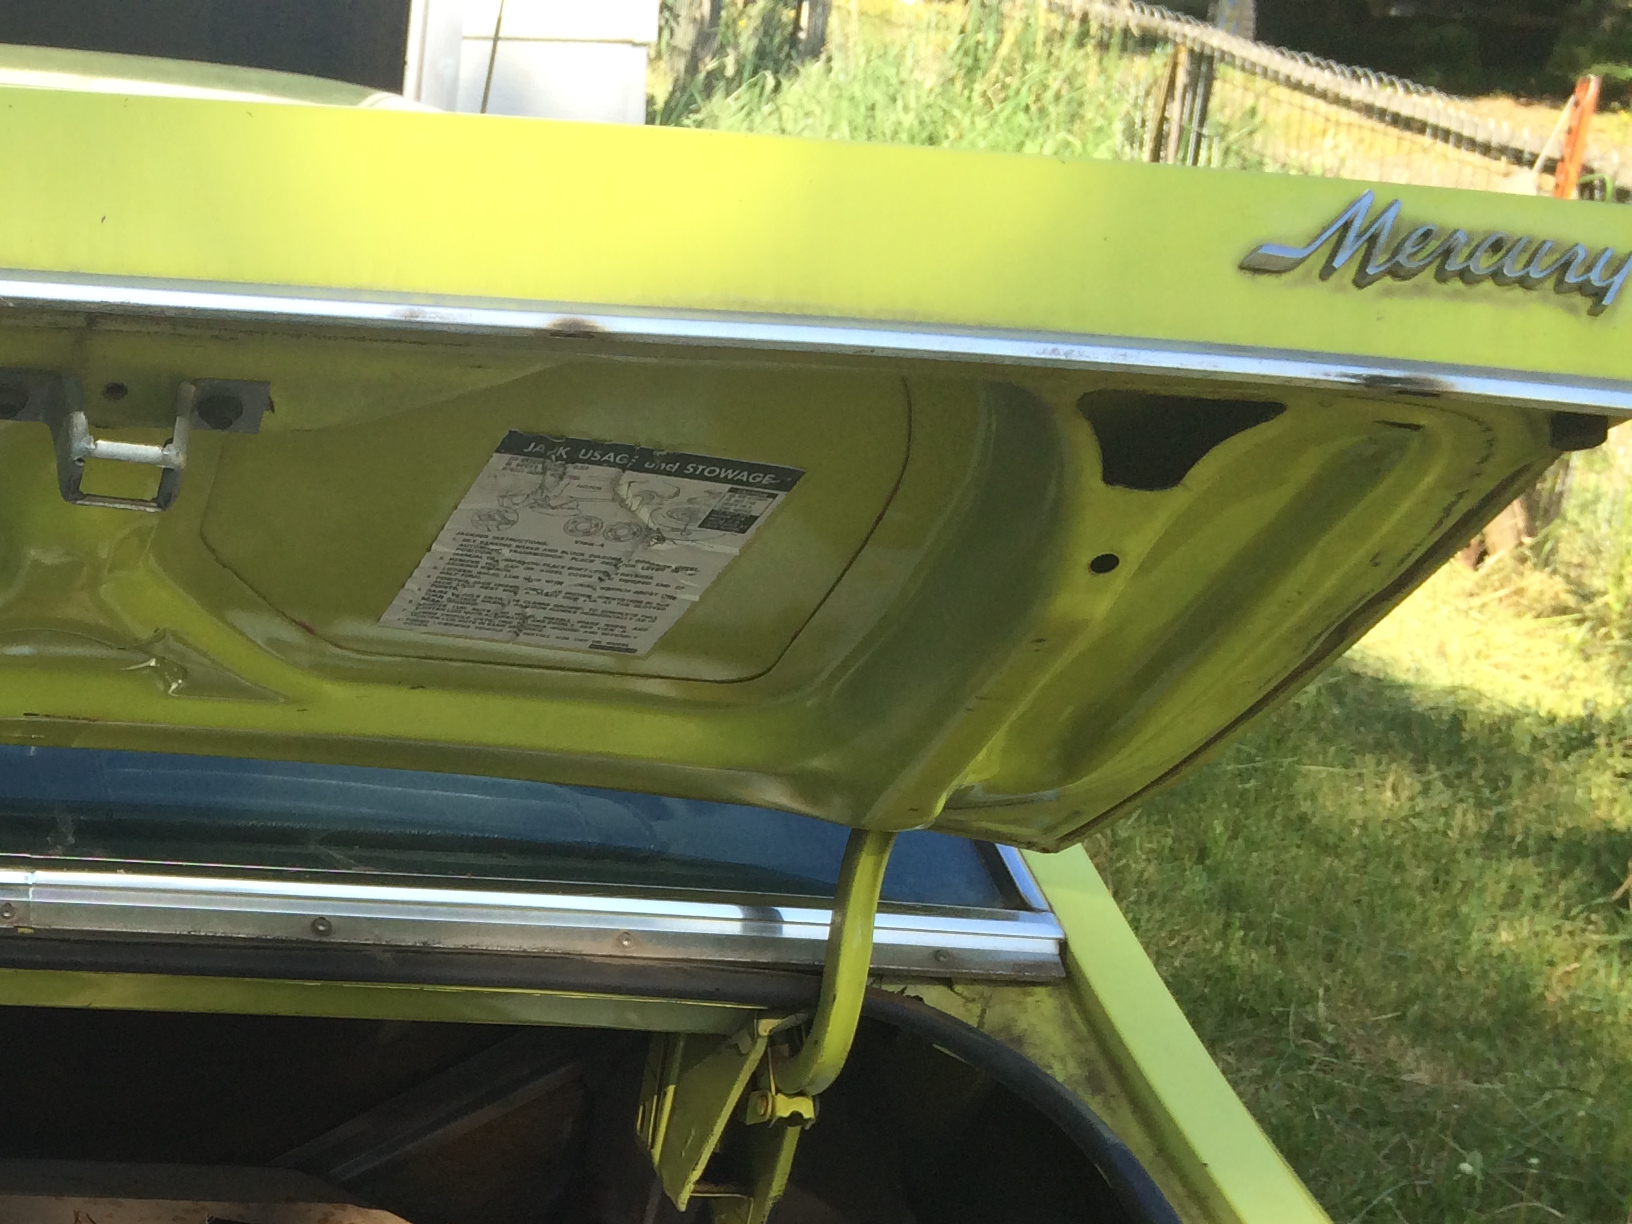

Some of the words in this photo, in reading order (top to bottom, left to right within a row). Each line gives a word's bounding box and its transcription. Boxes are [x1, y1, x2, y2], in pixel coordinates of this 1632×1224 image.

[1238, 189, 1632, 317] Mercury
[644, 461, 680, 473] and
[683, 463, 779, 485] STOWAGE
